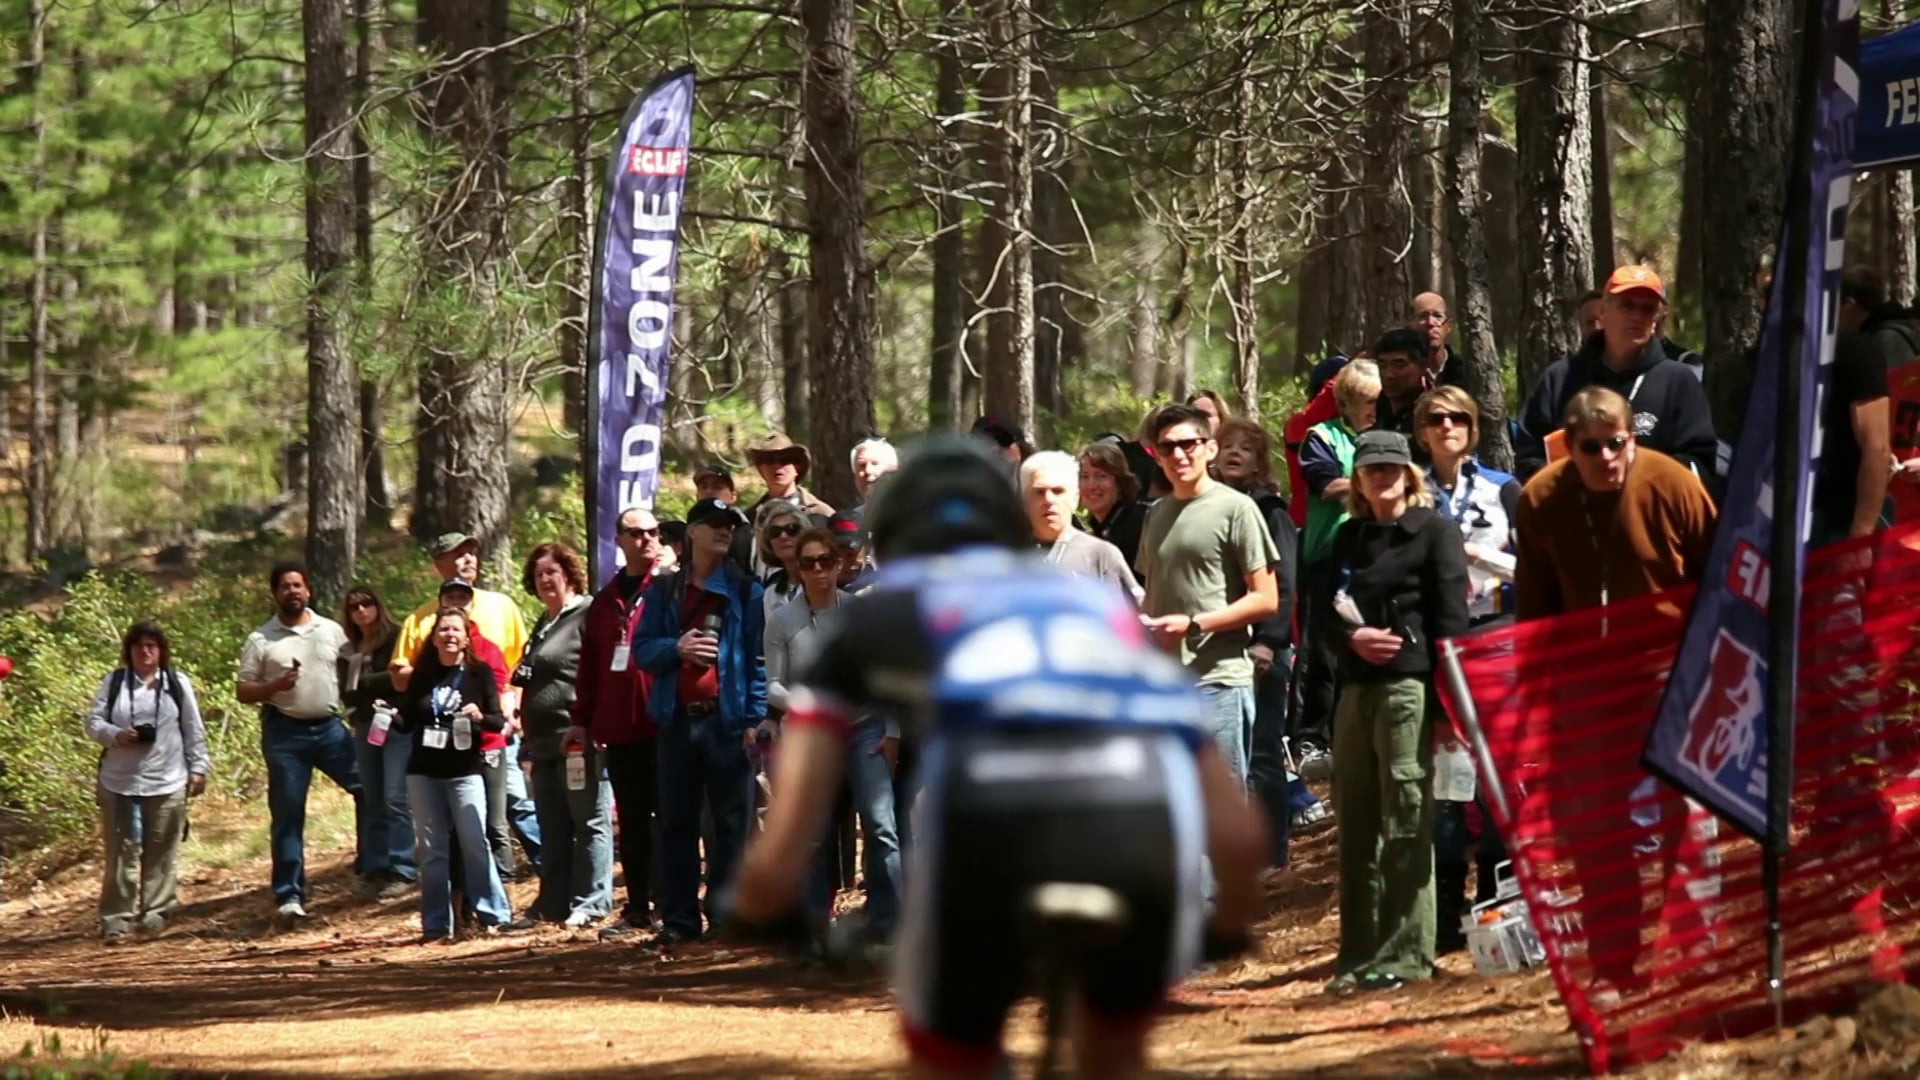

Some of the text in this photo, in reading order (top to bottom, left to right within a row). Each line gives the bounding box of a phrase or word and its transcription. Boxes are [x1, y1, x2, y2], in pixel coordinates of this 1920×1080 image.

[1884, 77, 1920, 127] FE
[616, 190, 679, 566] ED ZONE
